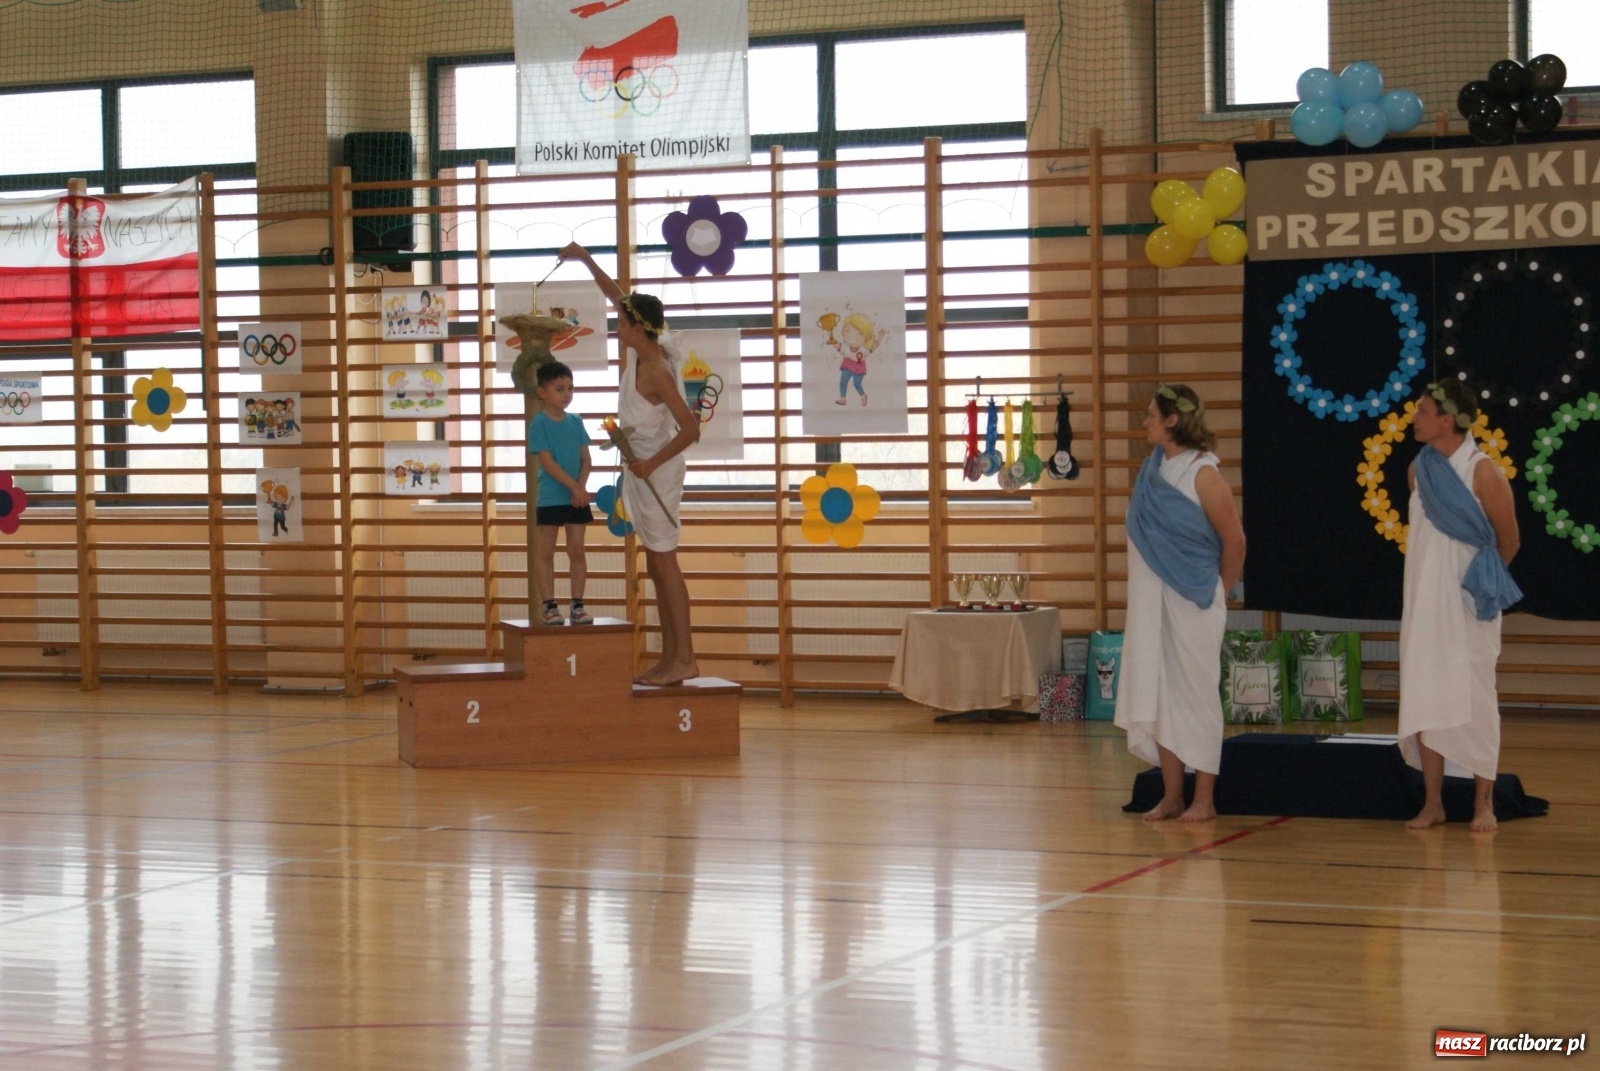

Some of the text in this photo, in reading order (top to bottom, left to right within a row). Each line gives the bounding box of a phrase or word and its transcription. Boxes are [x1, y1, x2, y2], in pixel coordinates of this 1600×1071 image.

[535, 132, 730, 161] Polski Komitet Olimpijski
[1304, 149, 1600, 199] SPARTAKI
[566, 654, 578, 677] 1
[1237, 676, 1267, 696] Green
[1303, 668, 1333, 688] Green
[466, 700, 480, 724] 2
[678, 708, 692, 732] 3
